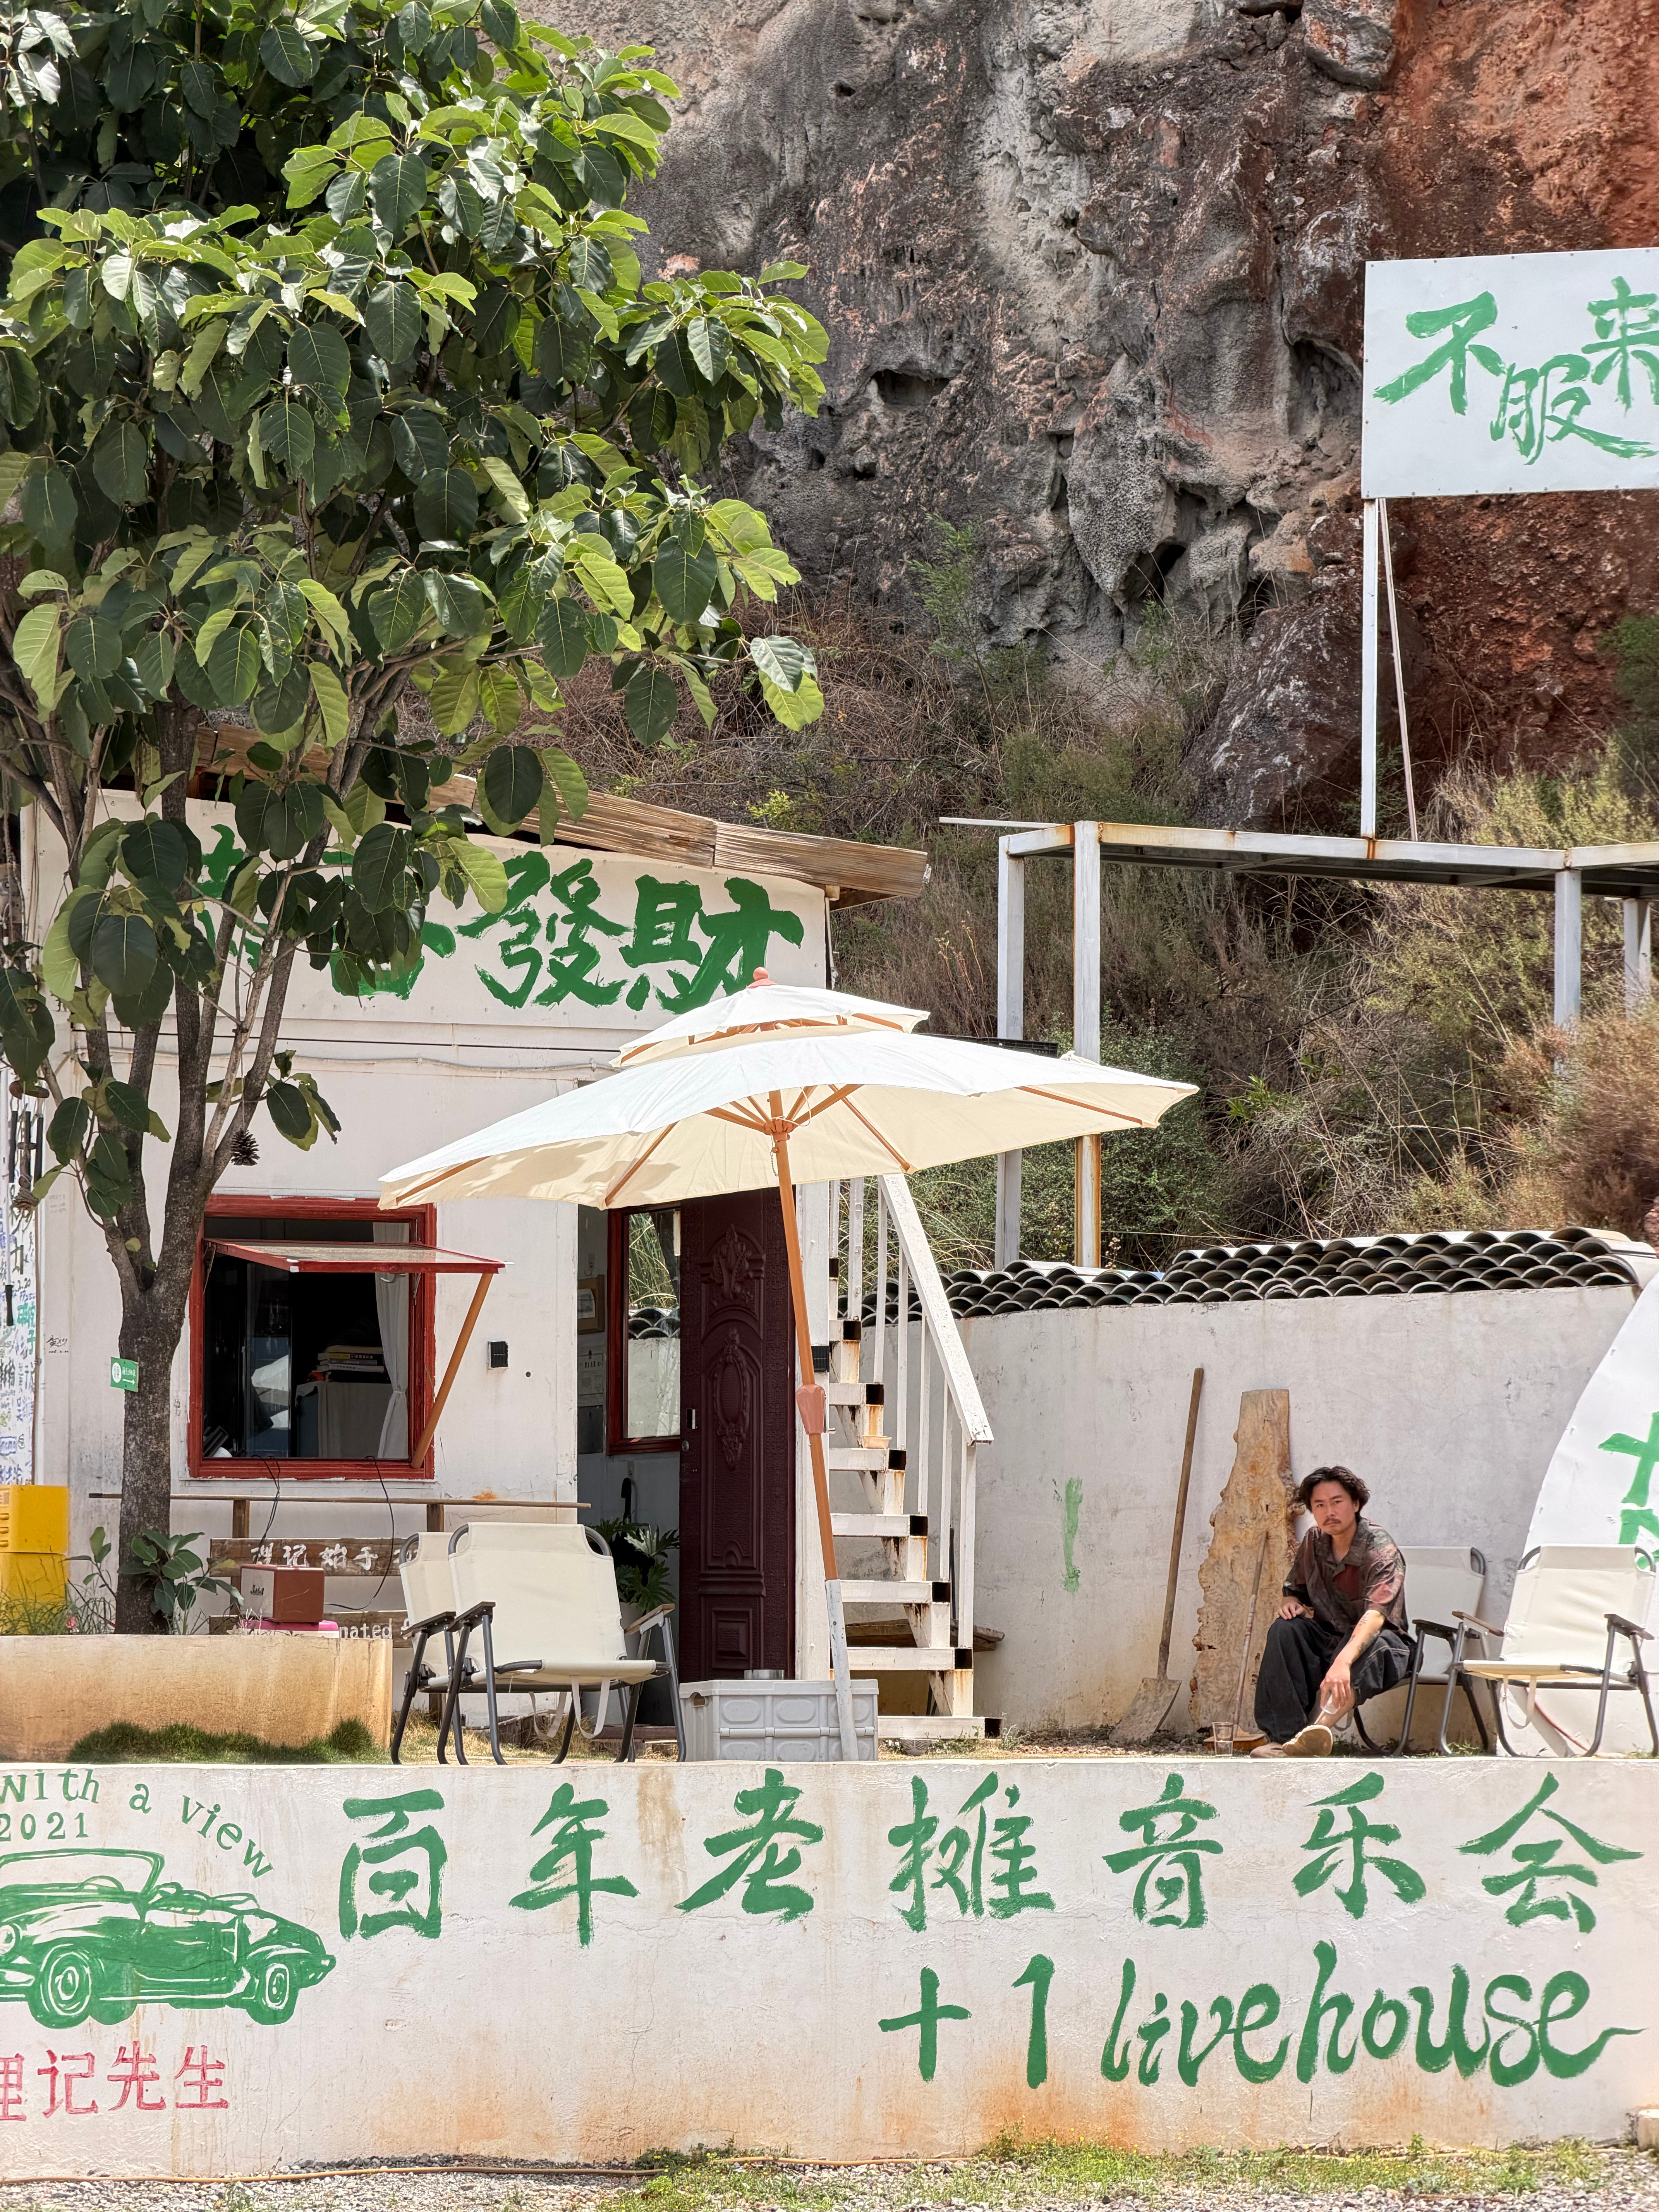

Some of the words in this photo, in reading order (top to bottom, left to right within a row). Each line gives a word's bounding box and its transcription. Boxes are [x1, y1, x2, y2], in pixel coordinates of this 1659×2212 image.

[191, 823, 805, 1015] 發財
[339, 1618, 393, 1639] nated
[0, 1811, 89, 1842] 2021
[129, 1783, 152, 1814] a
[182, 1795, 275, 1878] view
[339, 1769, 1644, 1946] 百年老摊音乐会
[1100, 1940, 1646, 2088] livehouse
